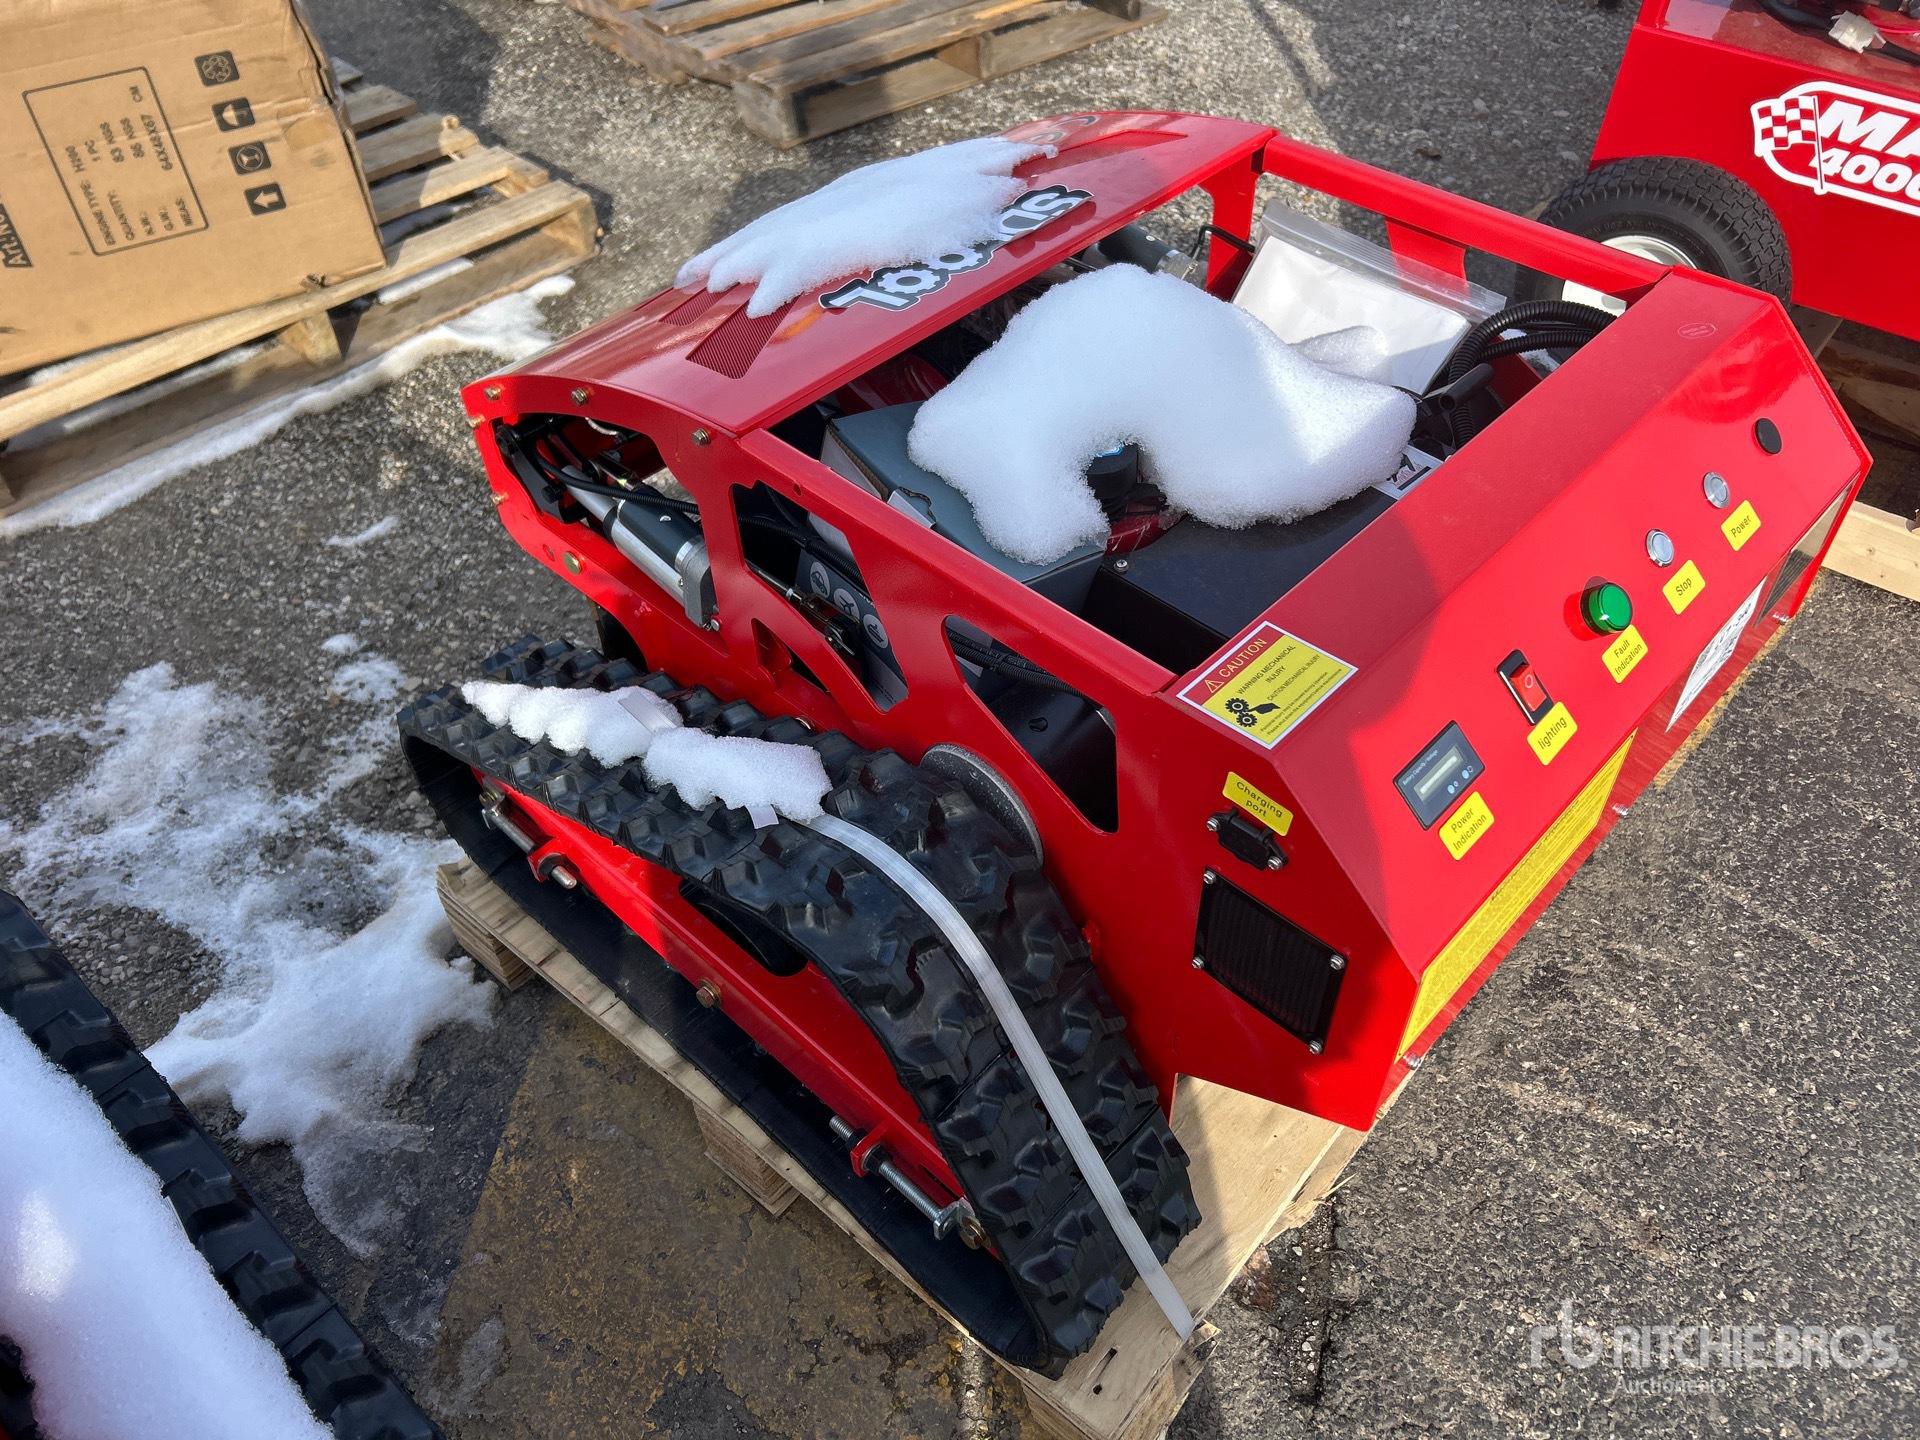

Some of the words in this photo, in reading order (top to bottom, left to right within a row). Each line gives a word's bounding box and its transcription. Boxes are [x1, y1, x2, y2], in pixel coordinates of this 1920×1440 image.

[1730, 515, 1752, 538] Power
[1675, 578, 1692, 596] Stop
[1218, 638, 1268, 678] CAUTION
[1613, 639, 1631, 659] Fault
[1614, 644, 1643, 675] Indication
[1237, 671, 1264, 695] WARNING
[1261, 645, 1296, 674] MECHANICAL
[1265, 665, 1287, 684] INJURY
[1267, 685, 1285, 701] CAUTION
[1284, 665, 1308, 687] MECHANICAL
[1537, 717, 1568, 750] lighting
[1236, 781, 1284, 818] Charging
[1245, 799, 1267, 818] port
[1450, 808, 1474, 834] Power
[1452, 814, 1487, 851] Indication
